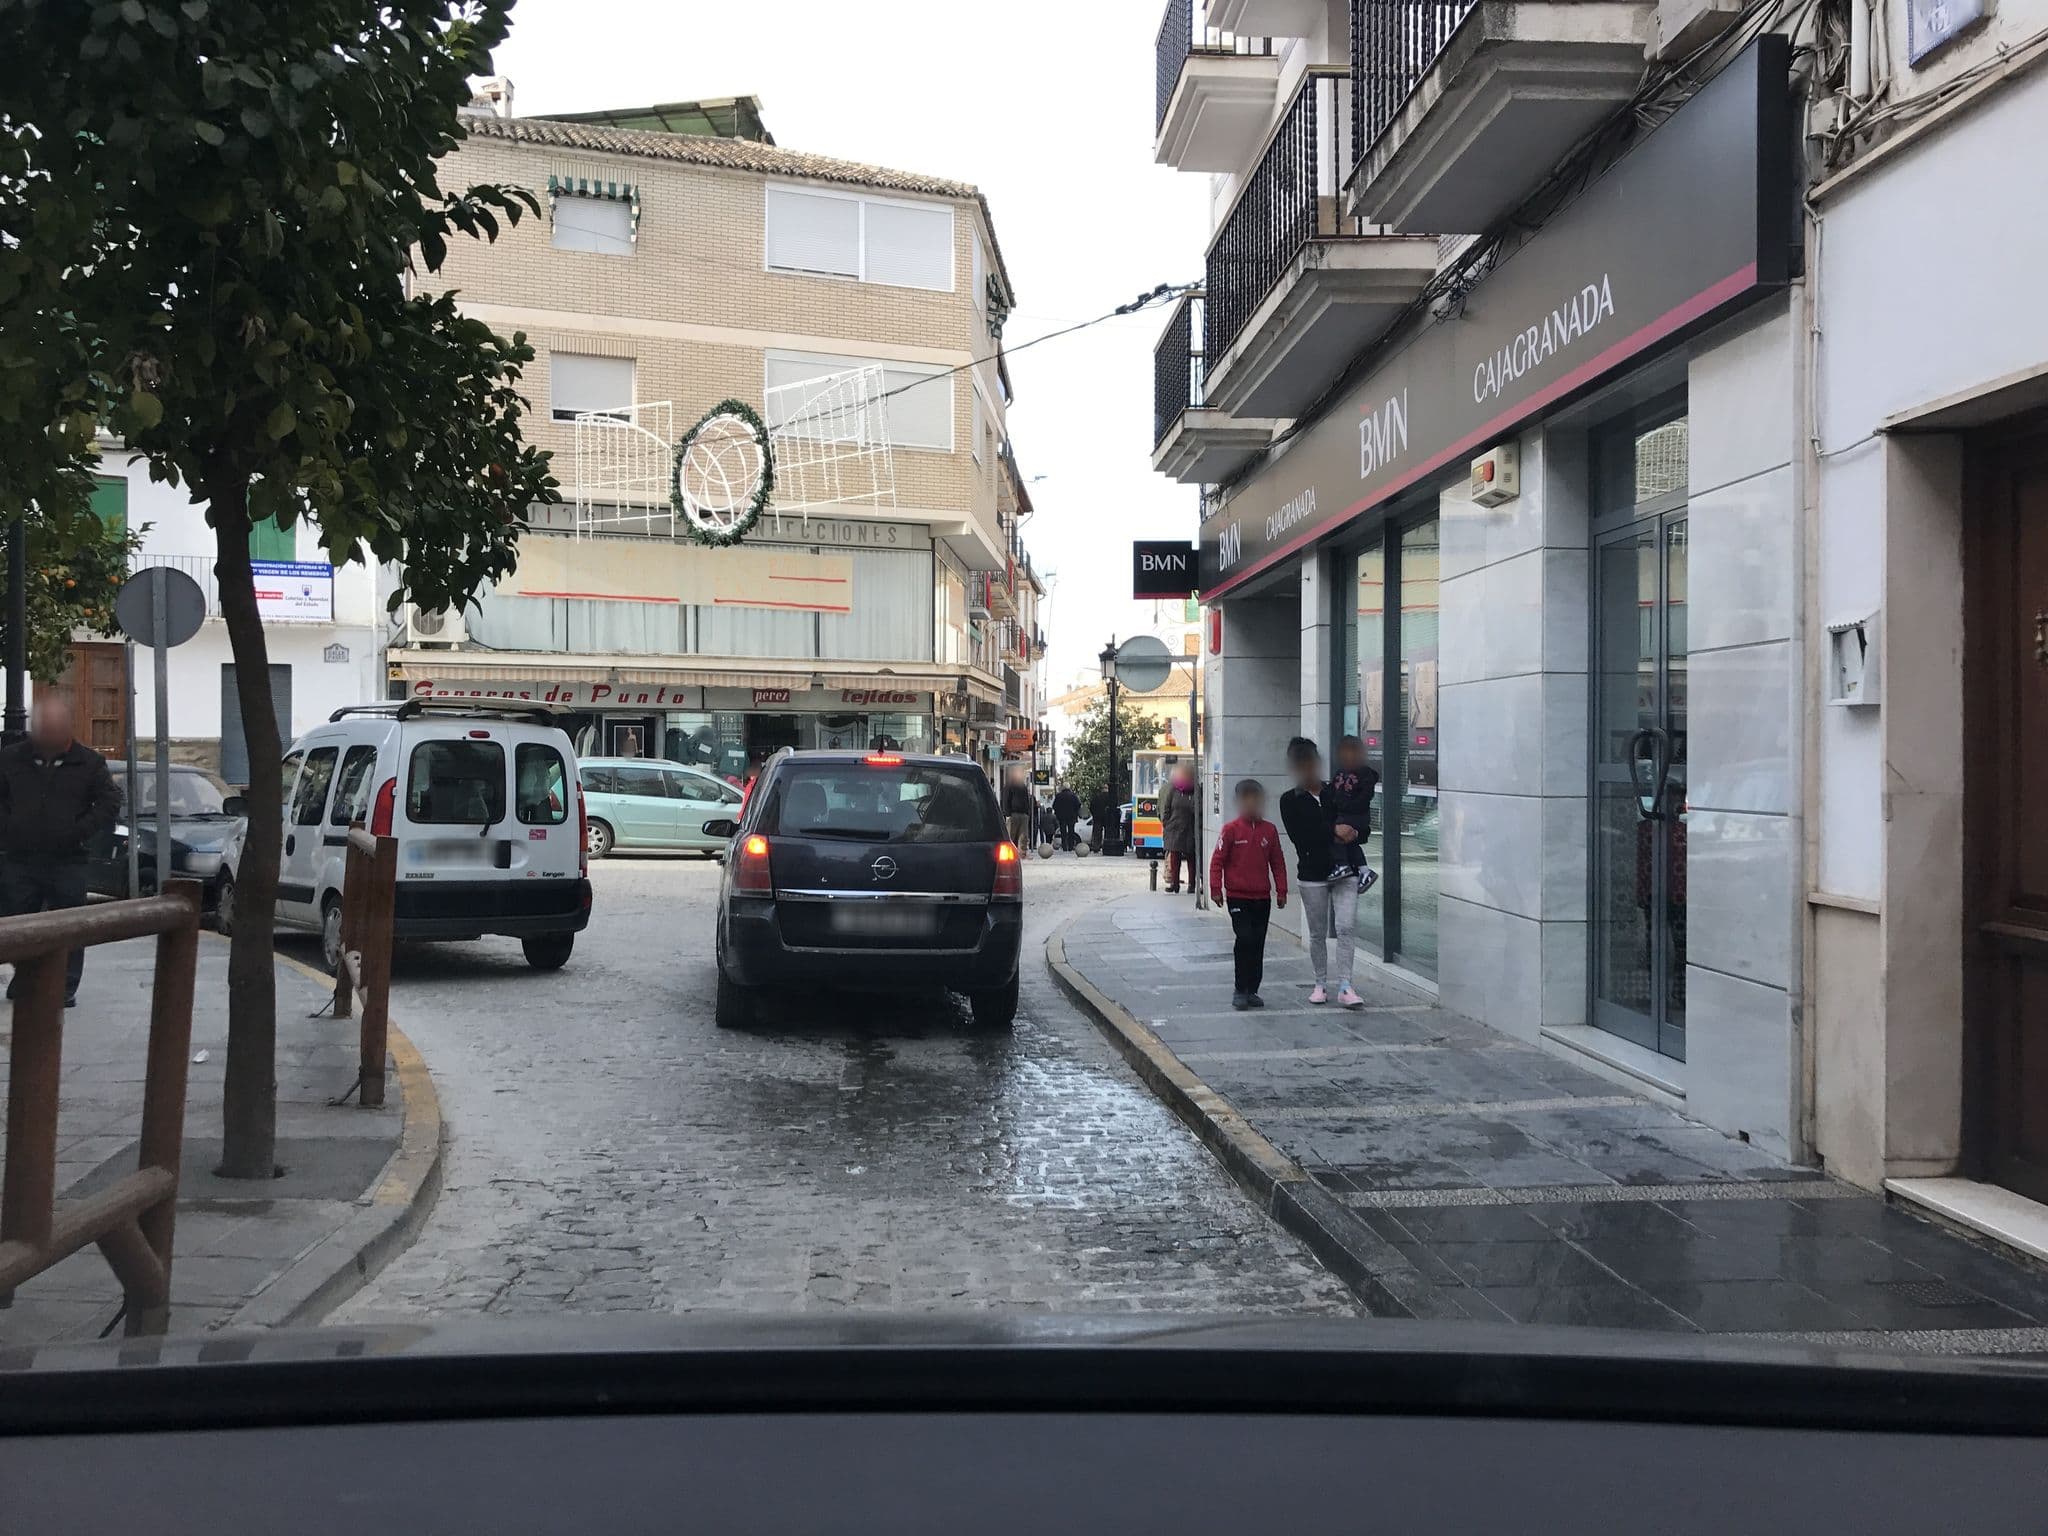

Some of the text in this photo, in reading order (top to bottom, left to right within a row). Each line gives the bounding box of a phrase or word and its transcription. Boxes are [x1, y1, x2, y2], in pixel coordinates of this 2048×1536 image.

[1474, 273, 1614, 403] CAJAGRANADA
[1359, 387, 1408, 479] BMN
[1266, 485, 1316, 541] CAJAGRANADA
[1140, 554, 1186, 571] BMN
[1219, 518, 1241, 573] BMN
[545, 685, 573, 702] de
[591, 684, 685, 704] Punto
